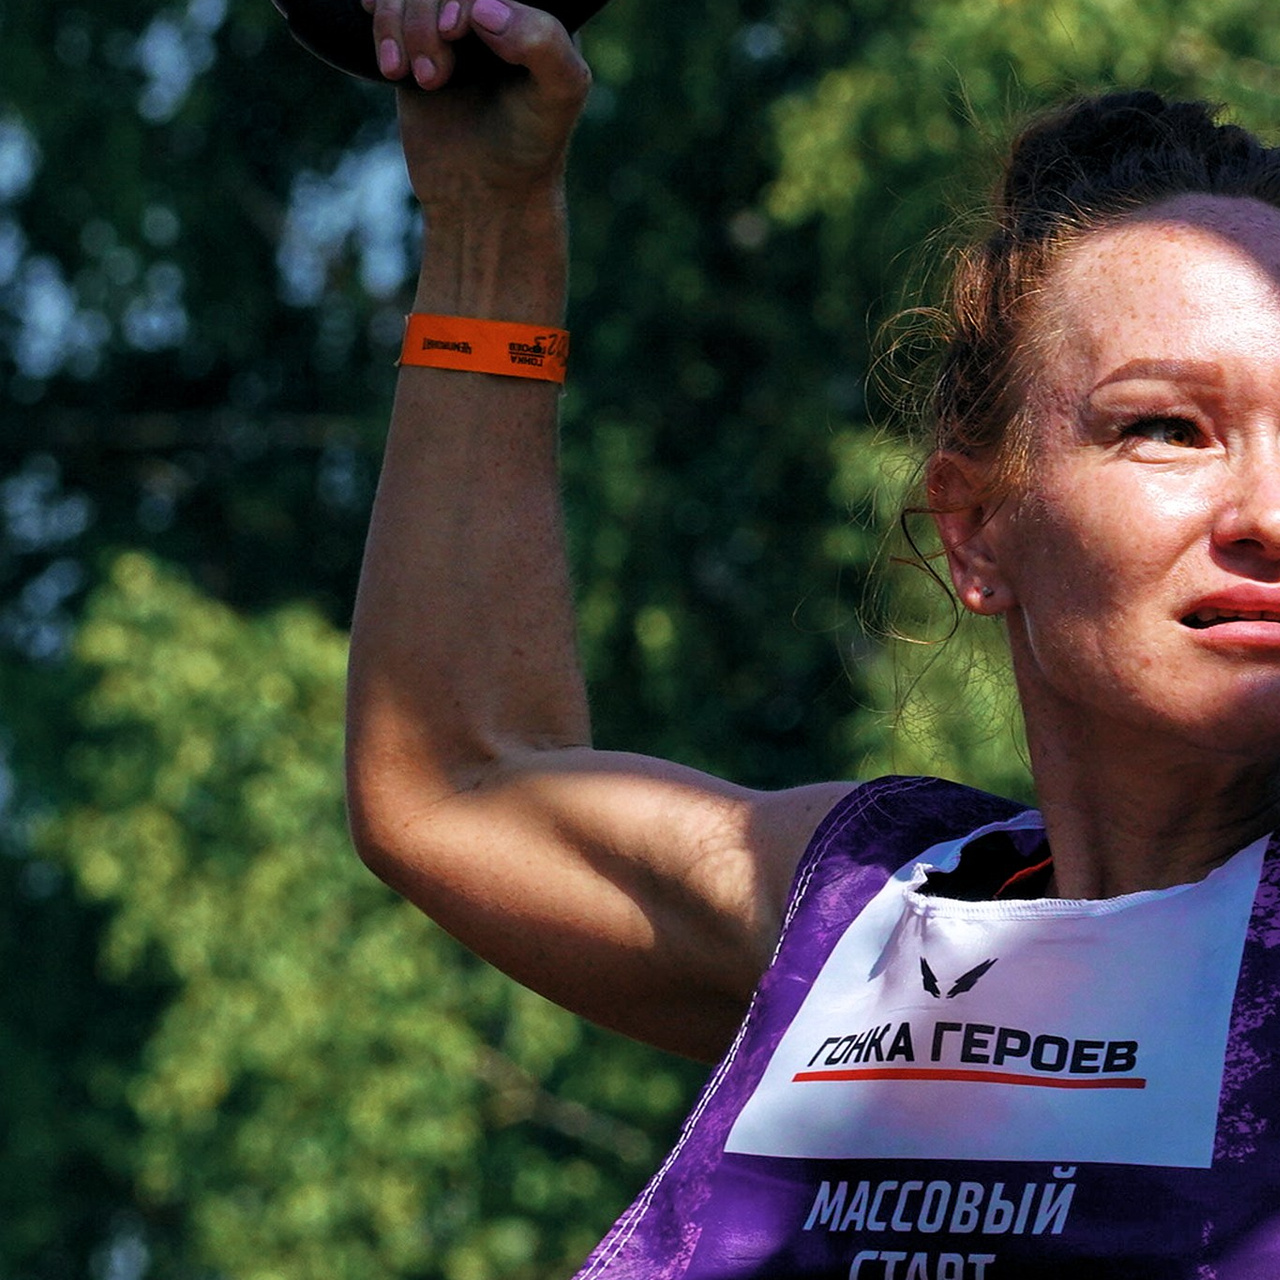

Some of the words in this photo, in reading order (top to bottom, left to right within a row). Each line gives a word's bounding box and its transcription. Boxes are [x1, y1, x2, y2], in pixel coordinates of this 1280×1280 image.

[508, 342, 546, 355] ГРОЕВ
[807, 1022, 915, 1067] ГОНКА
[930, 1022, 1139, 1073] ГЕРОЕВ
[802, 1166, 1077, 1235] МАССОВЫЙ
